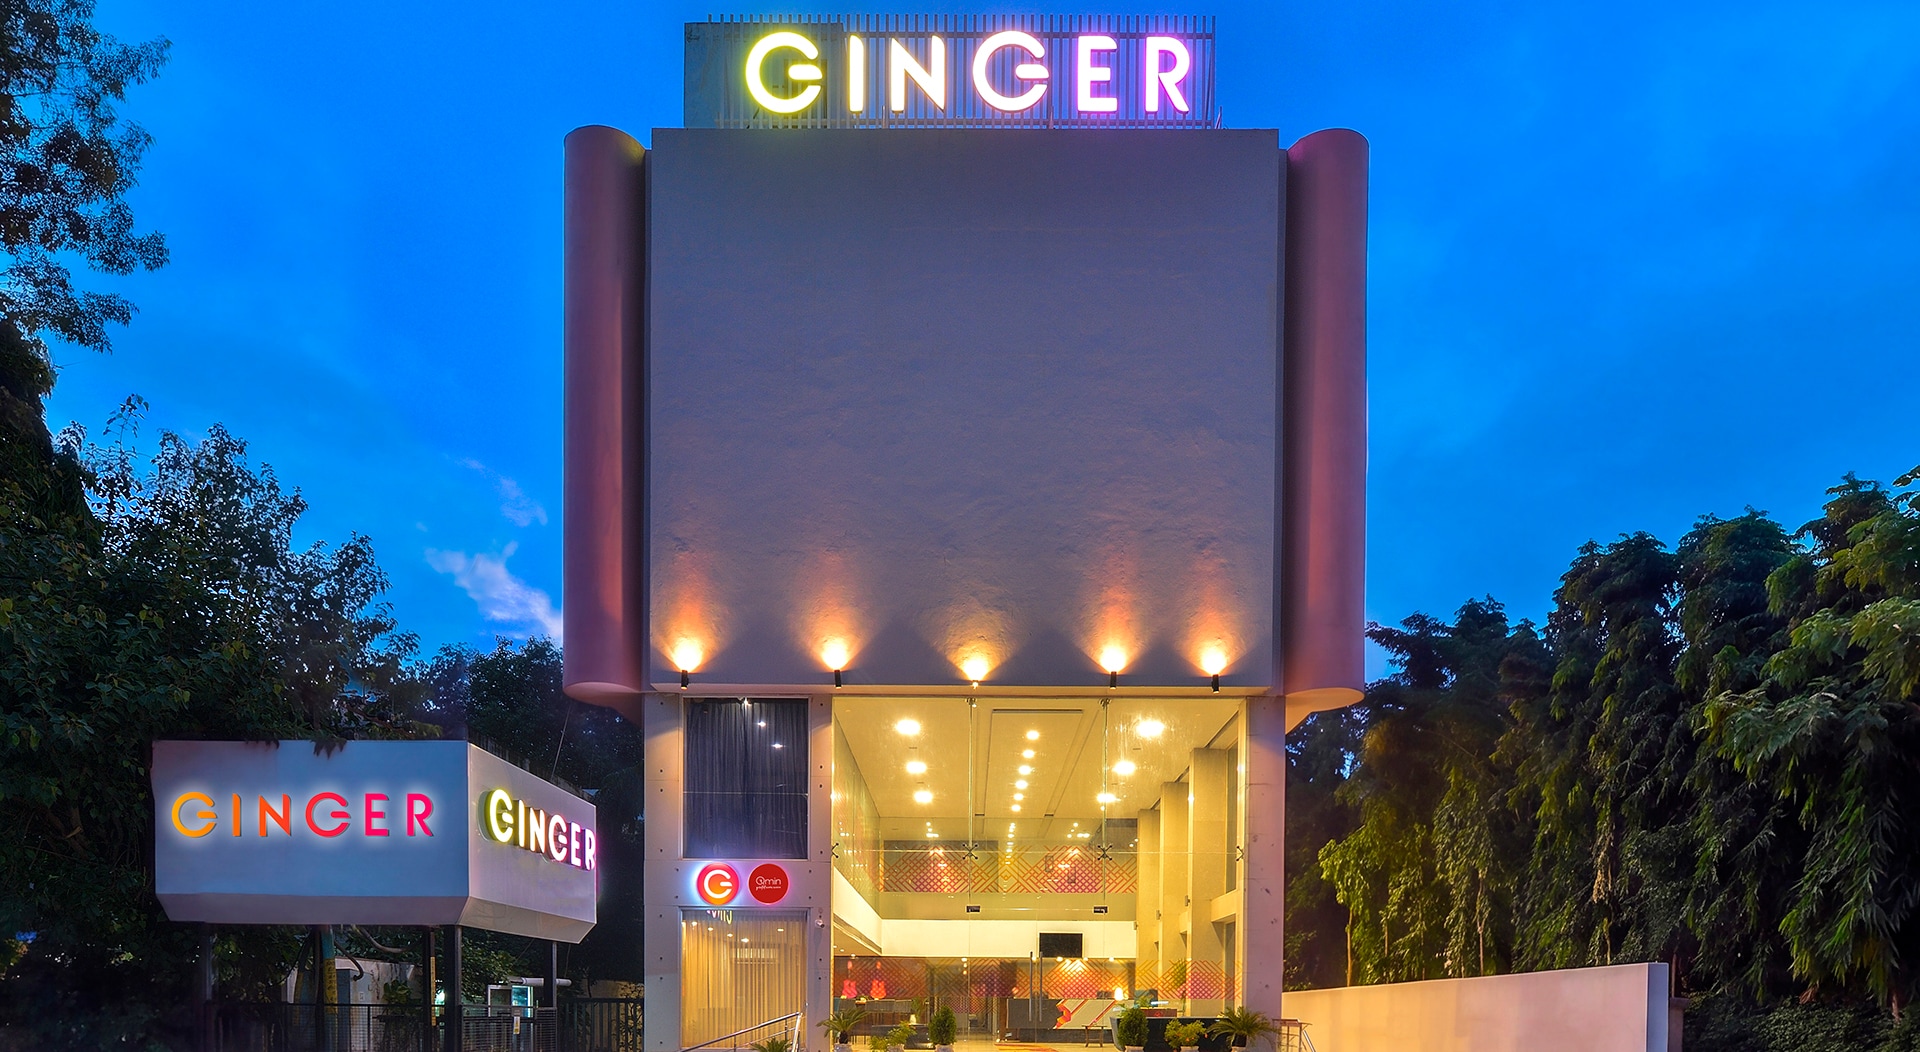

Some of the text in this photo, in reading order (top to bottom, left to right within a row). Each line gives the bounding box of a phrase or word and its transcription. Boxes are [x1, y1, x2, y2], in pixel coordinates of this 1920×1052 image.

[745, 30, 1190, 114] GINGER
[171, 791, 434, 838] GINGER
[488, 789, 596, 871] GINGER
